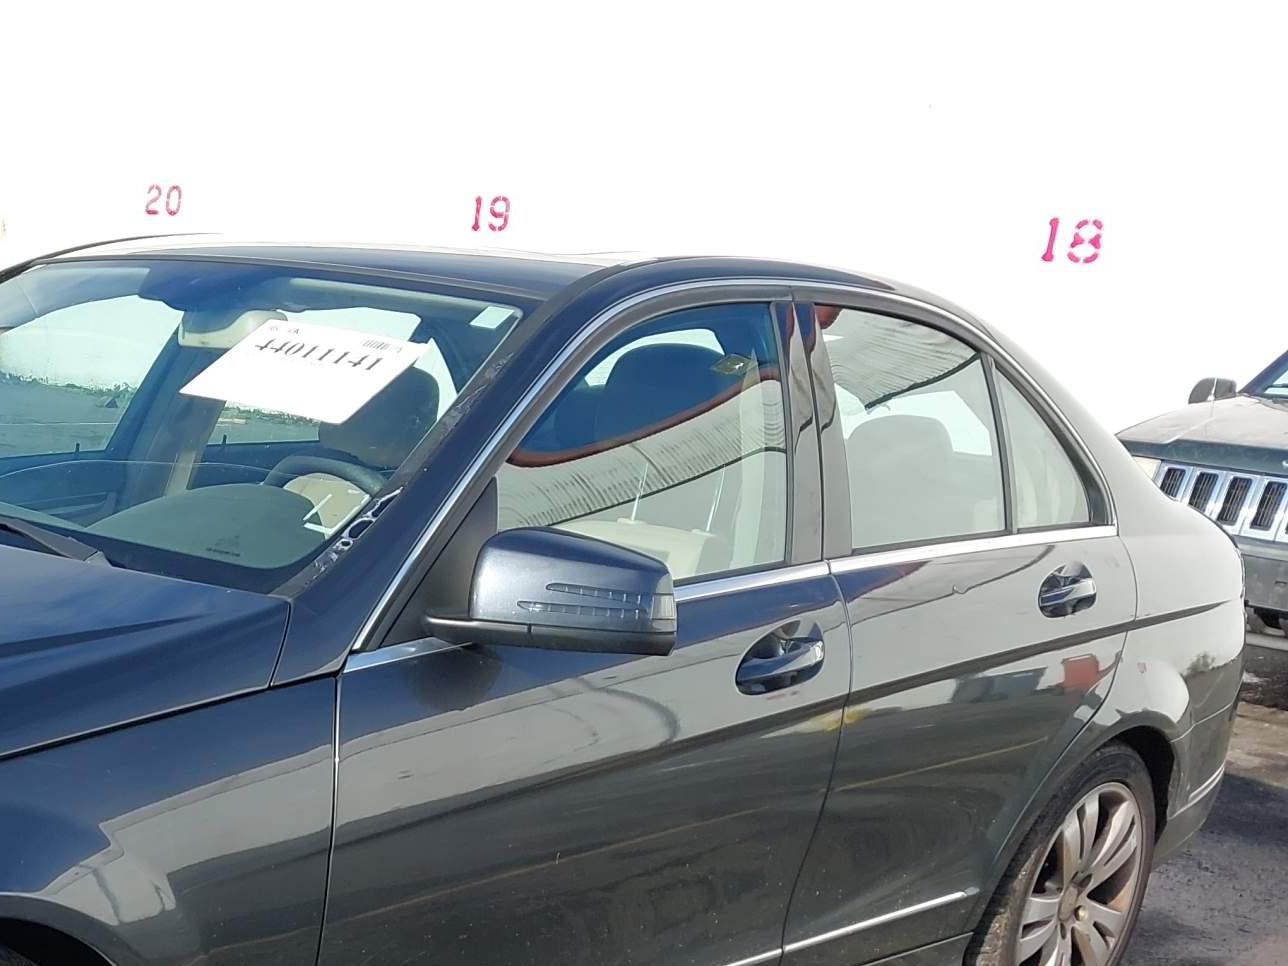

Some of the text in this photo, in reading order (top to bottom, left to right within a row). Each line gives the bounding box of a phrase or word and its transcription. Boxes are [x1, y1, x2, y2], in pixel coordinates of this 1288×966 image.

[144, 184, 182, 216] 20
[471, 195, 511, 232] 19
[1040, 217, 1103, 263] 18
[255, 338, 383, 371] 44011141
